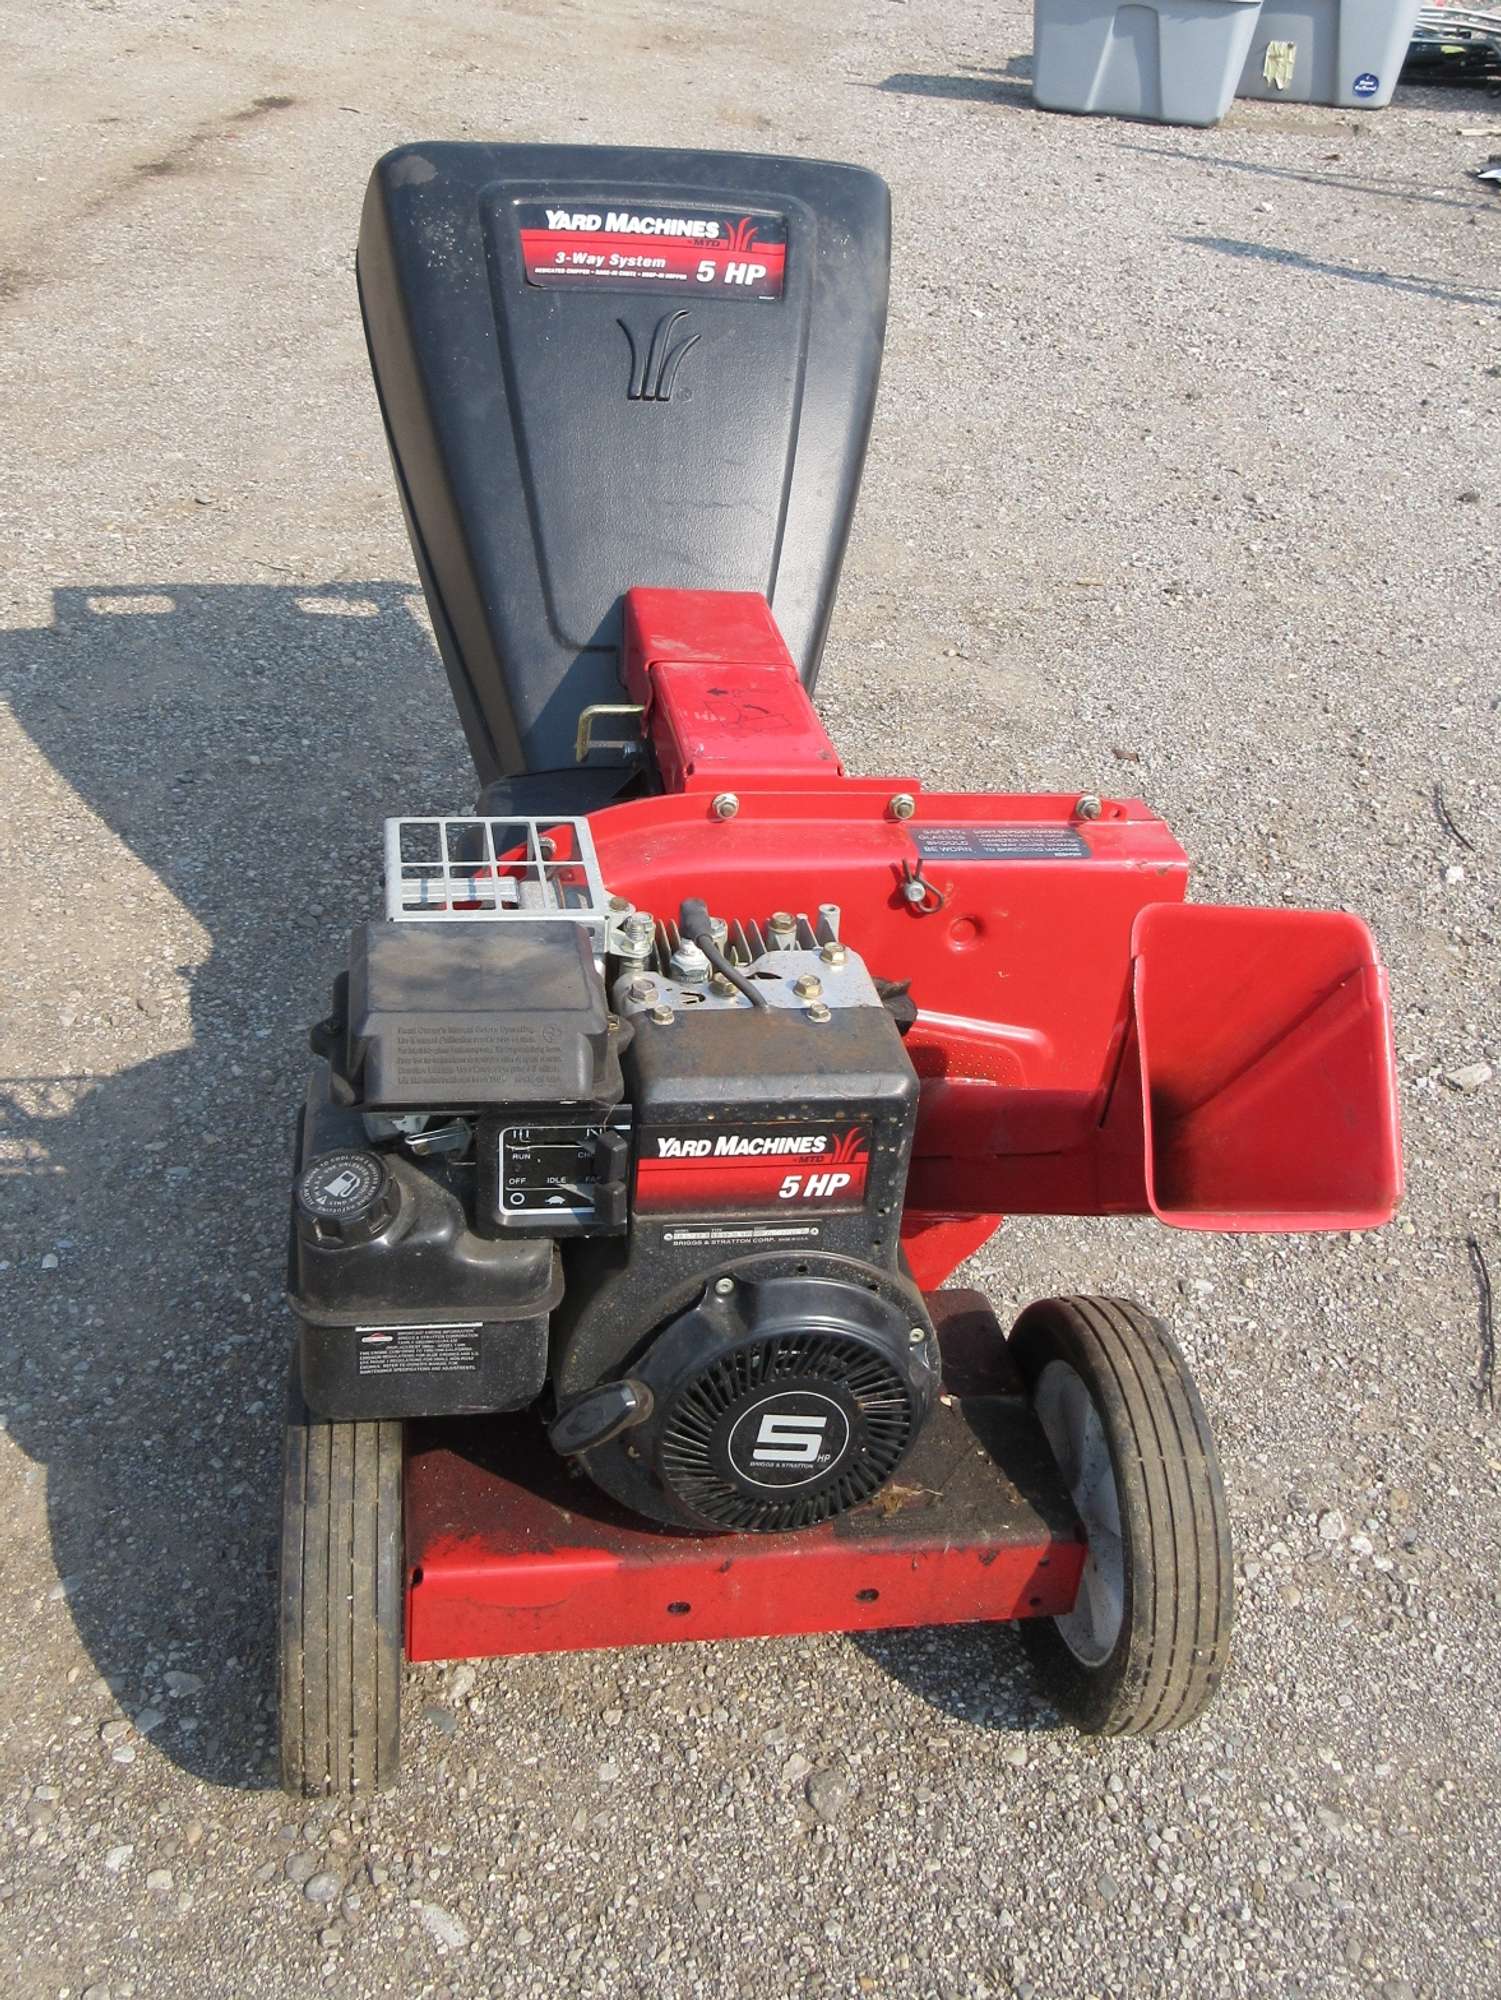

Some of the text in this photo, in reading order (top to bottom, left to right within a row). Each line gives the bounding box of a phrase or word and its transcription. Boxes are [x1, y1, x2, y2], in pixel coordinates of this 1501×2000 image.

[545, 209, 720, 239] YARD MACHINES
[555, 251, 666, 269] 3-Way System
[696, 260, 767, 286] 5 HP
[657, 1136, 827, 1158] YARD MACHINES
[547, 1176, 567, 1184] IDLE
[778, 1173, 851, 1199] 5 HP
[753, 1414, 827, 1462] 5
[816, 1454, 832, 1463] HP
